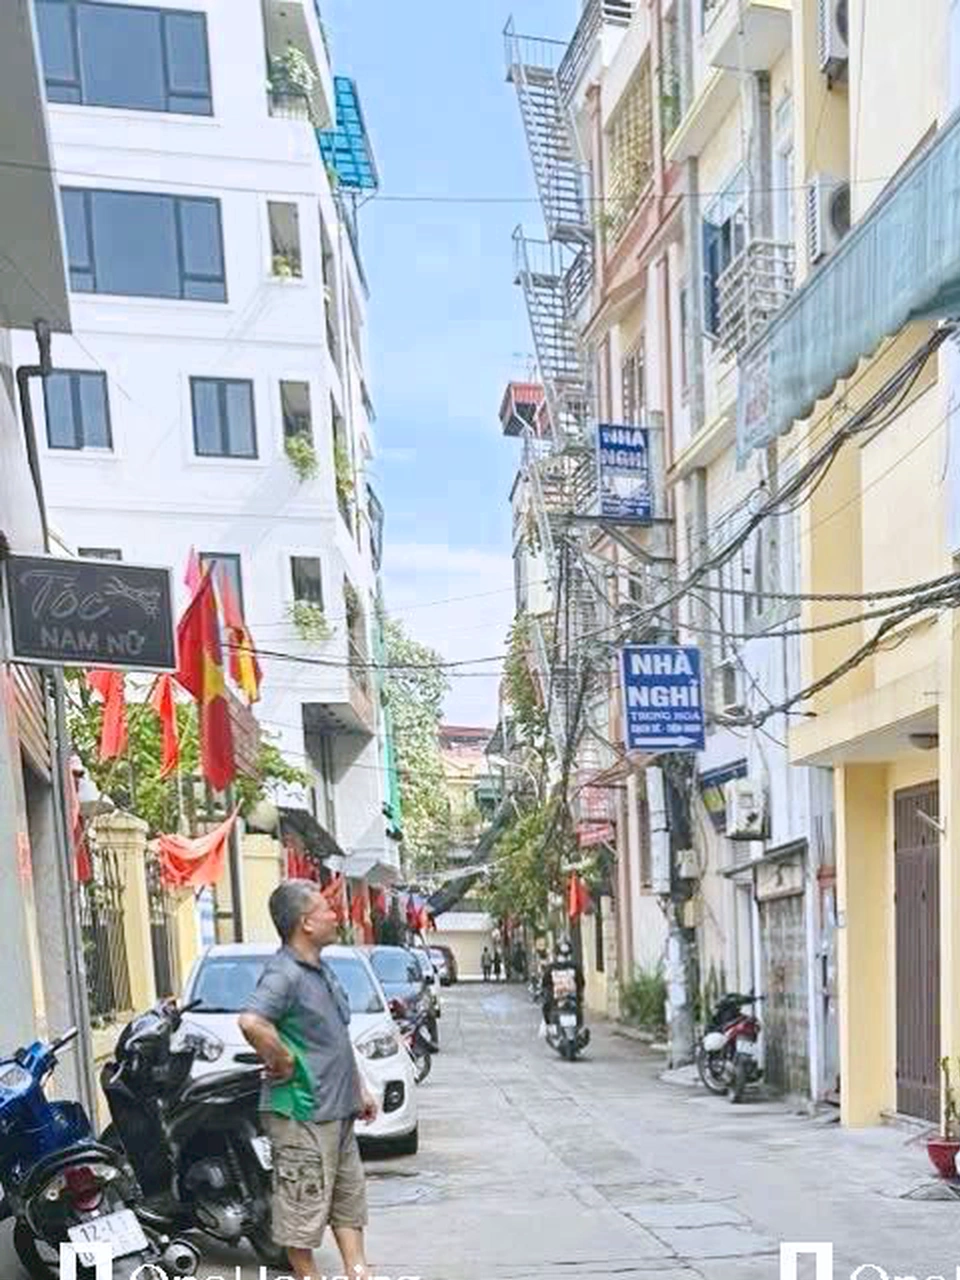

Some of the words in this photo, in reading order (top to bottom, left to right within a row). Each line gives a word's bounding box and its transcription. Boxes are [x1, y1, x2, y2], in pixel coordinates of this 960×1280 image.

[41, 626, 99, 653] NAM
[630, 649, 694, 675] NHÀ
[627, 678, 699, 707] NGHỈ
